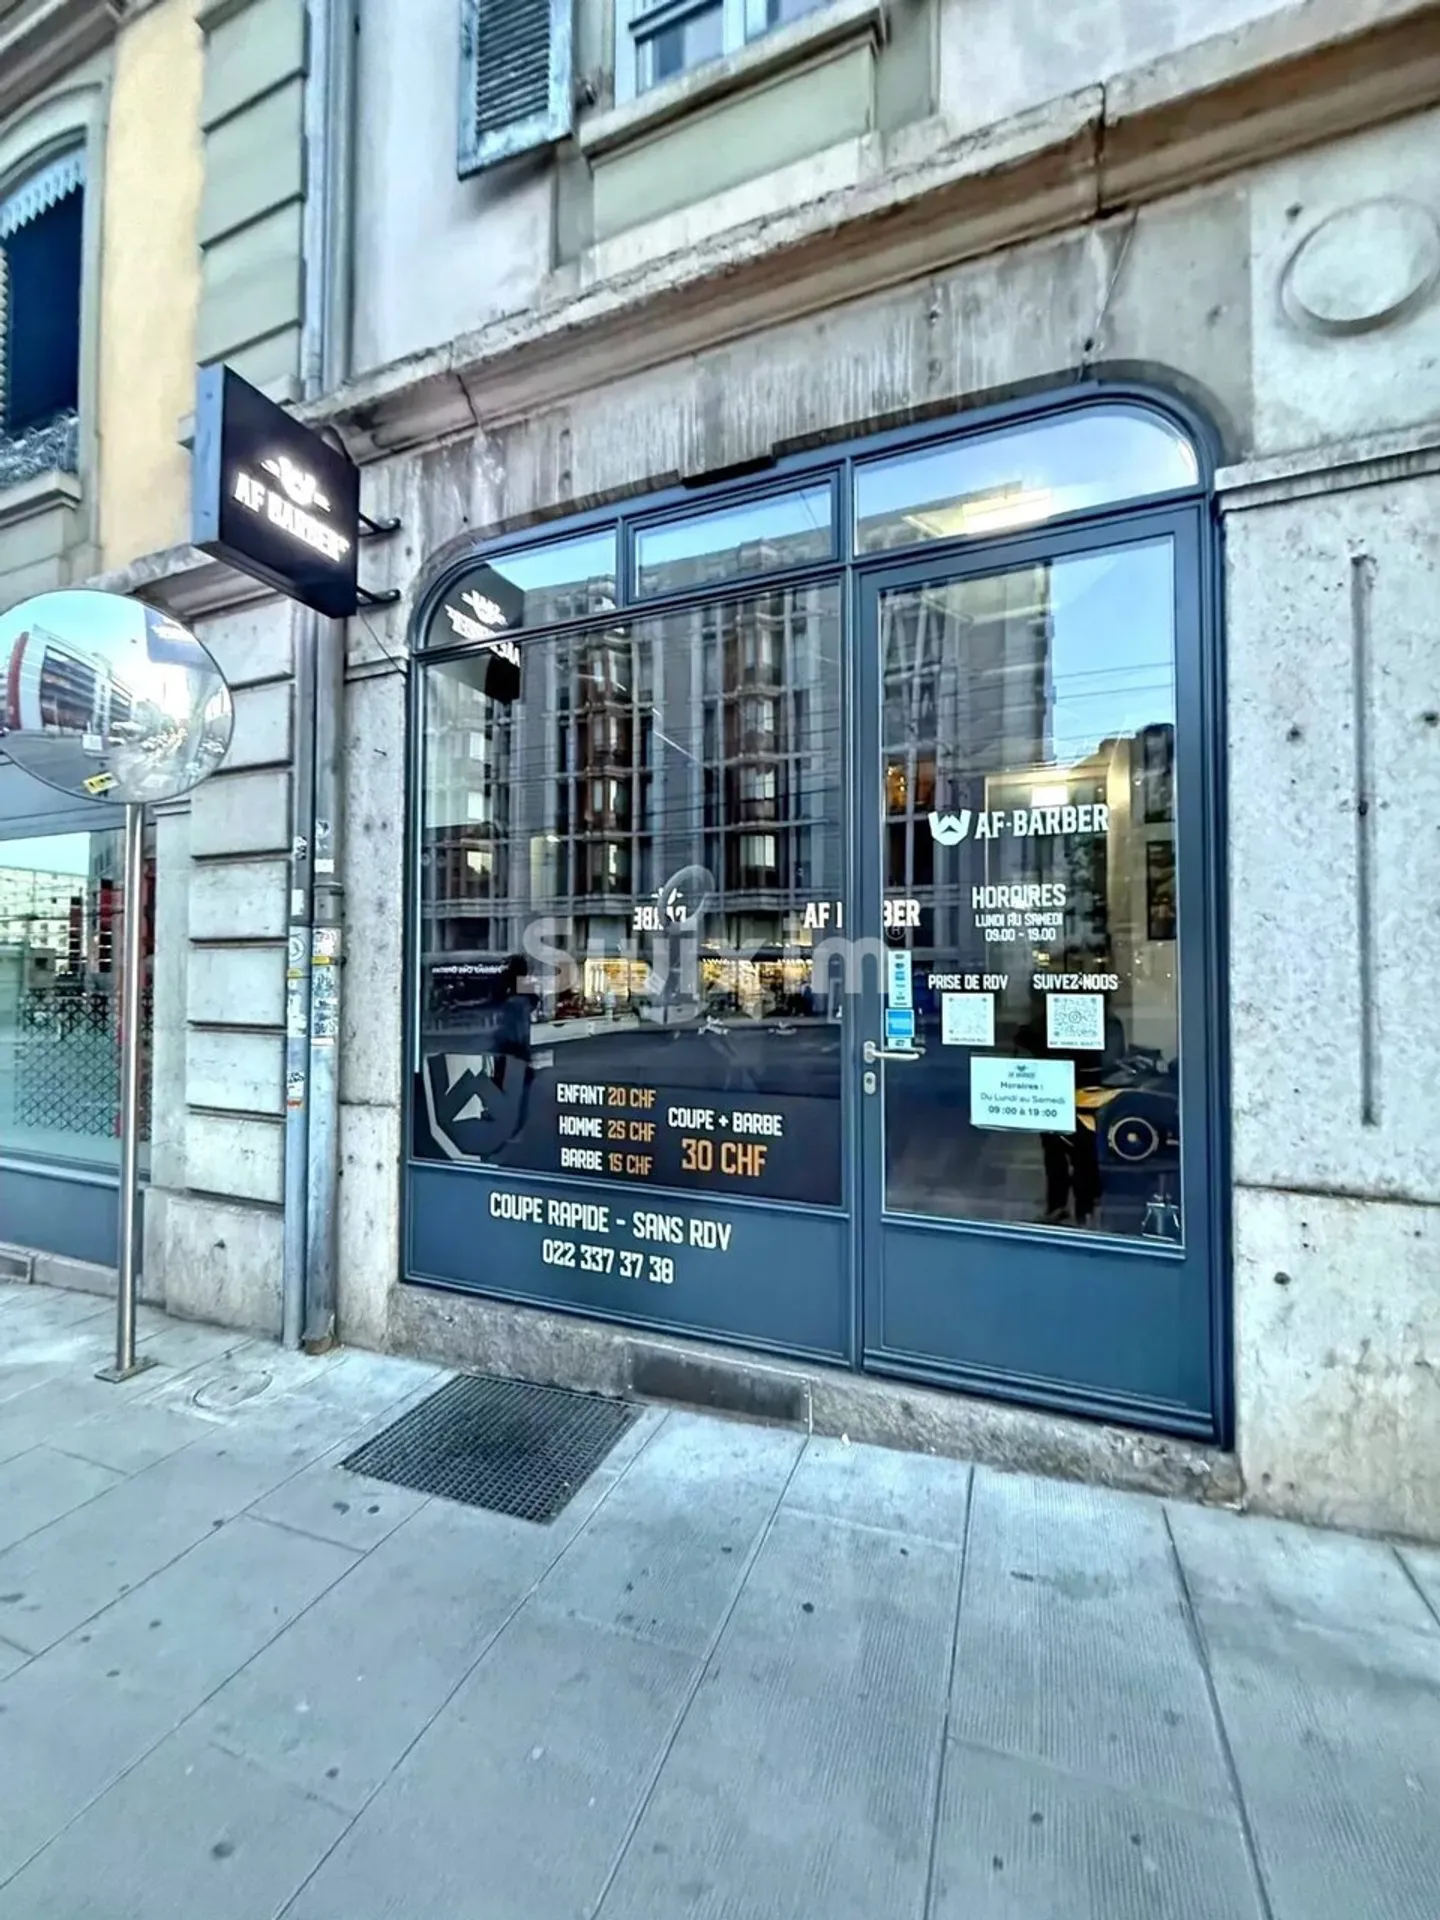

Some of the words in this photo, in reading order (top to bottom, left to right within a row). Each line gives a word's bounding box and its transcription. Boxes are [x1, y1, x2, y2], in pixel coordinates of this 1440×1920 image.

[233, 472, 265, 512] AF
[975, 804, 1109, 840] AF-BARBER
[972, 884, 1067, 909] HORAIRES
[803, 902, 830, 928] AF
[975, 914, 1005, 927] LUNDI
[1007, 912, 1022, 927] AU
[1024, 912, 1063, 926] SAMEDI
[928, 974, 961, 990] PRISE
[964, 974, 980, 990] DE
[983, 975, 1009, 990] RDV
[557, 1083, 605, 1105] ENFANT
[608, 1086, 625, 1106] 20
[630, 1088, 656, 1108] CHF
[981, 1092, 992, 1101] Du
[994, 1093, 1017, 1102] Lundi
[1032, 1095, 1066, 1104] Samedi
[1001, 1081, 1038, 1090] Horaires
[559, 1116, 602, 1138] HOMME
[607, 1120, 625, 1139] 25
[630, 1122, 656, 1142] CHF
[668, 1107, 714, 1130] COUPE
[718, 1117, 729, 1128] +
[732, 1112, 782, 1136] BARBE
[561, 1148, 602, 1170] BARBE
[608, 1152, 623, 1171] 15
[627, 1155, 653, 1175] CHF
[682, 1138, 712, 1171] 30
[721, 1142, 768, 1176] CHF
[490, 1192, 543, 1223] COUPE
[548, 1199, 609, 1233] RAPIDE
[633, 1212, 683, 1244] SANS
[690, 1219, 732, 1251] RDV
[543, 1239, 575, 1267] 022
[581, 1244, 614, 1273] 337
[620, 1251, 643, 1278] 37
[649, 1255, 674, 1284] 38
